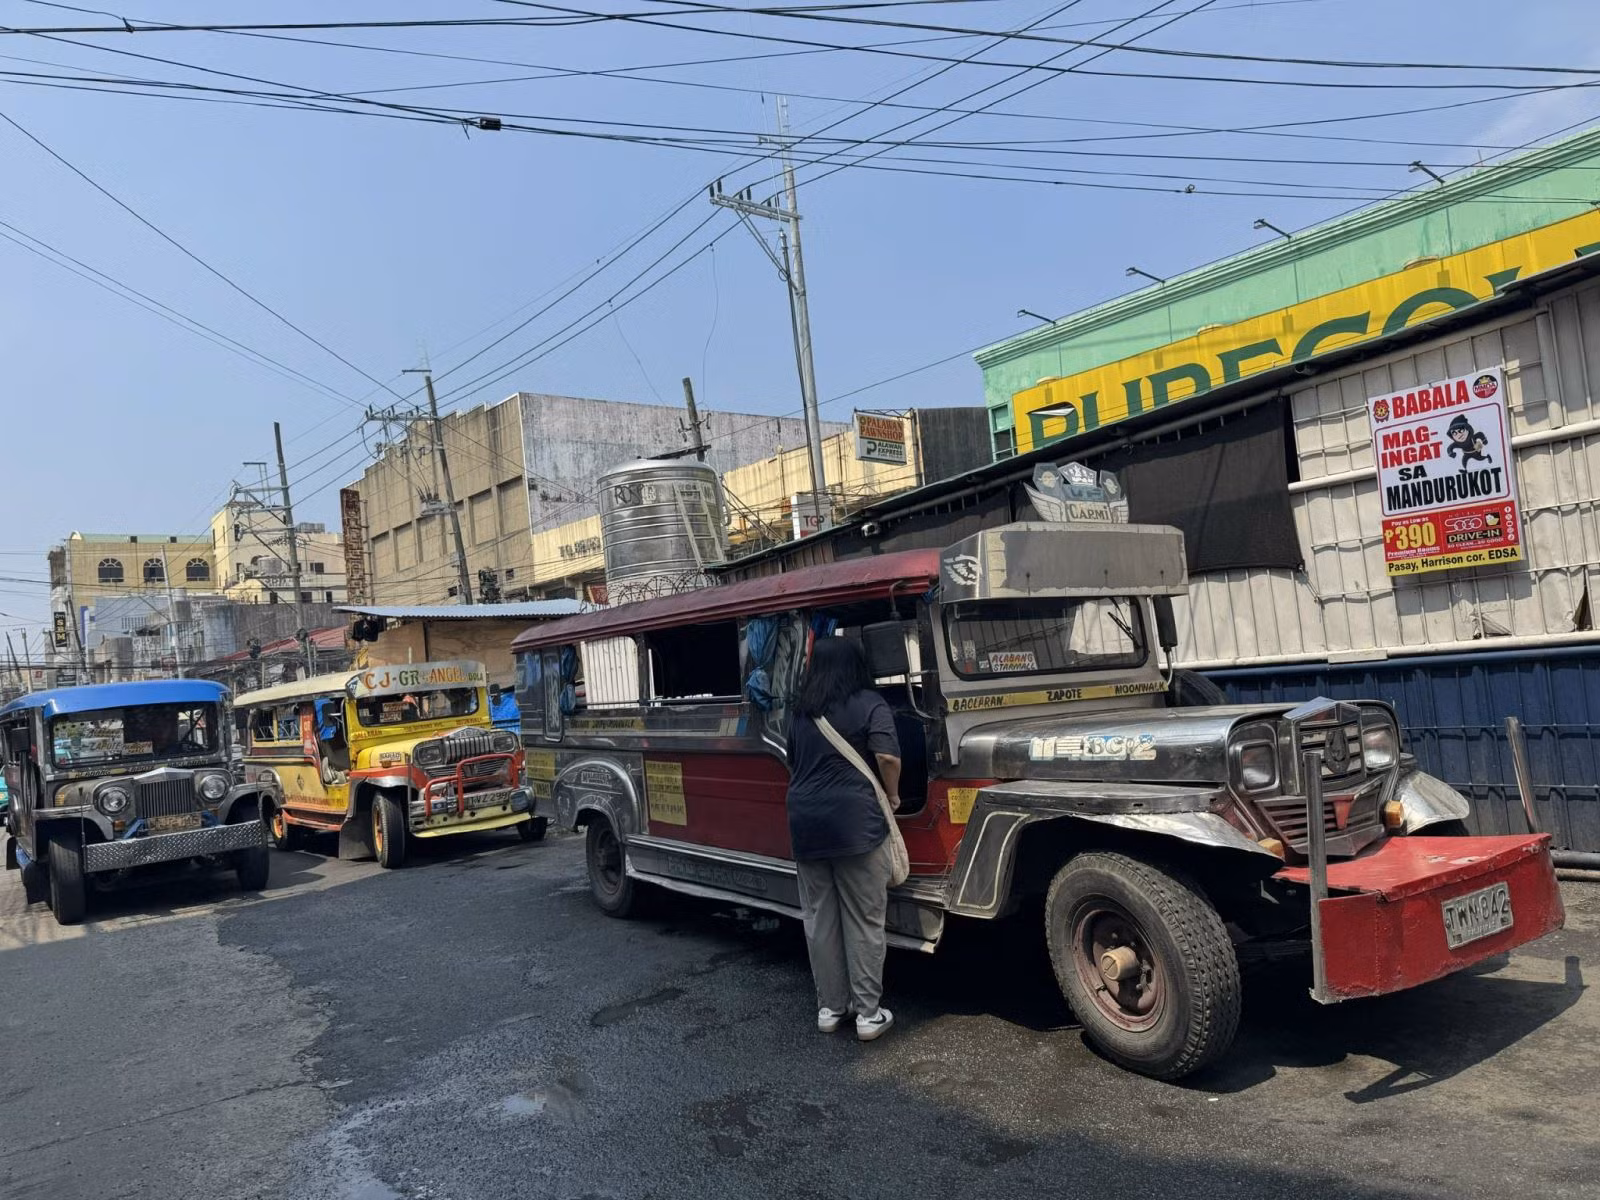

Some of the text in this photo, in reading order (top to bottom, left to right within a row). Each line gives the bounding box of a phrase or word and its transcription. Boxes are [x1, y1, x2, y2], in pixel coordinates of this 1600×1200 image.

[1391, 380, 1470, 419] BABALA
[860, 425, 903, 441] PAWNSHOP
[1382, 425, 1438, 450] MAG-
[1381, 441, 1443, 469] INGAT
[1399, 465, 1428, 481] SA
[1386, 467, 1502, 511] MANDURUKOT
[1448, 529, 1500, 543] DRIVE-IN
[1388, 561, 1419, 573] Pasay,
[1421, 556, 1463, 568] Harrison
[1466, 553, 1485, 563] cor.
[1488, 547, 1518, 560] EDSA
[992, 653, 1034, 663] ALABANG
[953, 681, 1165, 711] BACLARAN ZAPOTE MOONWALK
